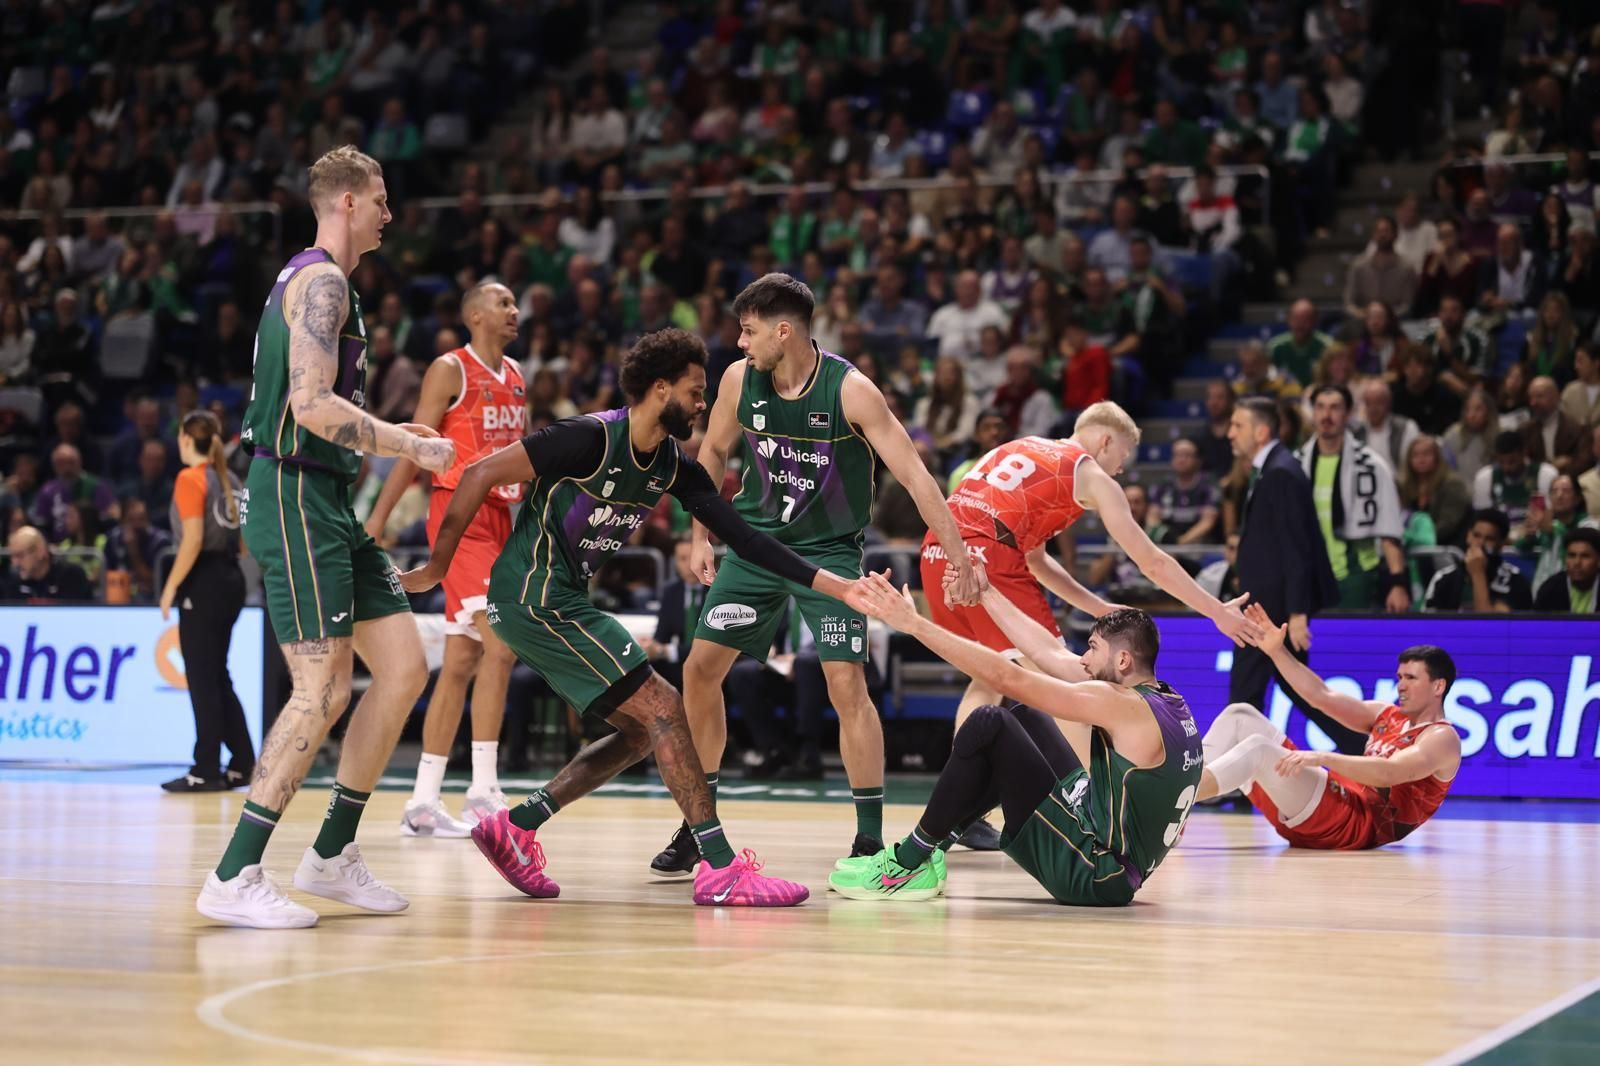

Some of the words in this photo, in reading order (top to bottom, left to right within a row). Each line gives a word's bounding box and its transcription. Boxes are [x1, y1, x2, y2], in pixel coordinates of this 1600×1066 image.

[781, 446, 829, 468] Unicaja
[962, 449, 1037, 492] 18
[781, 495, 796, 523] 7
[0, 710, 87, 742] istics
